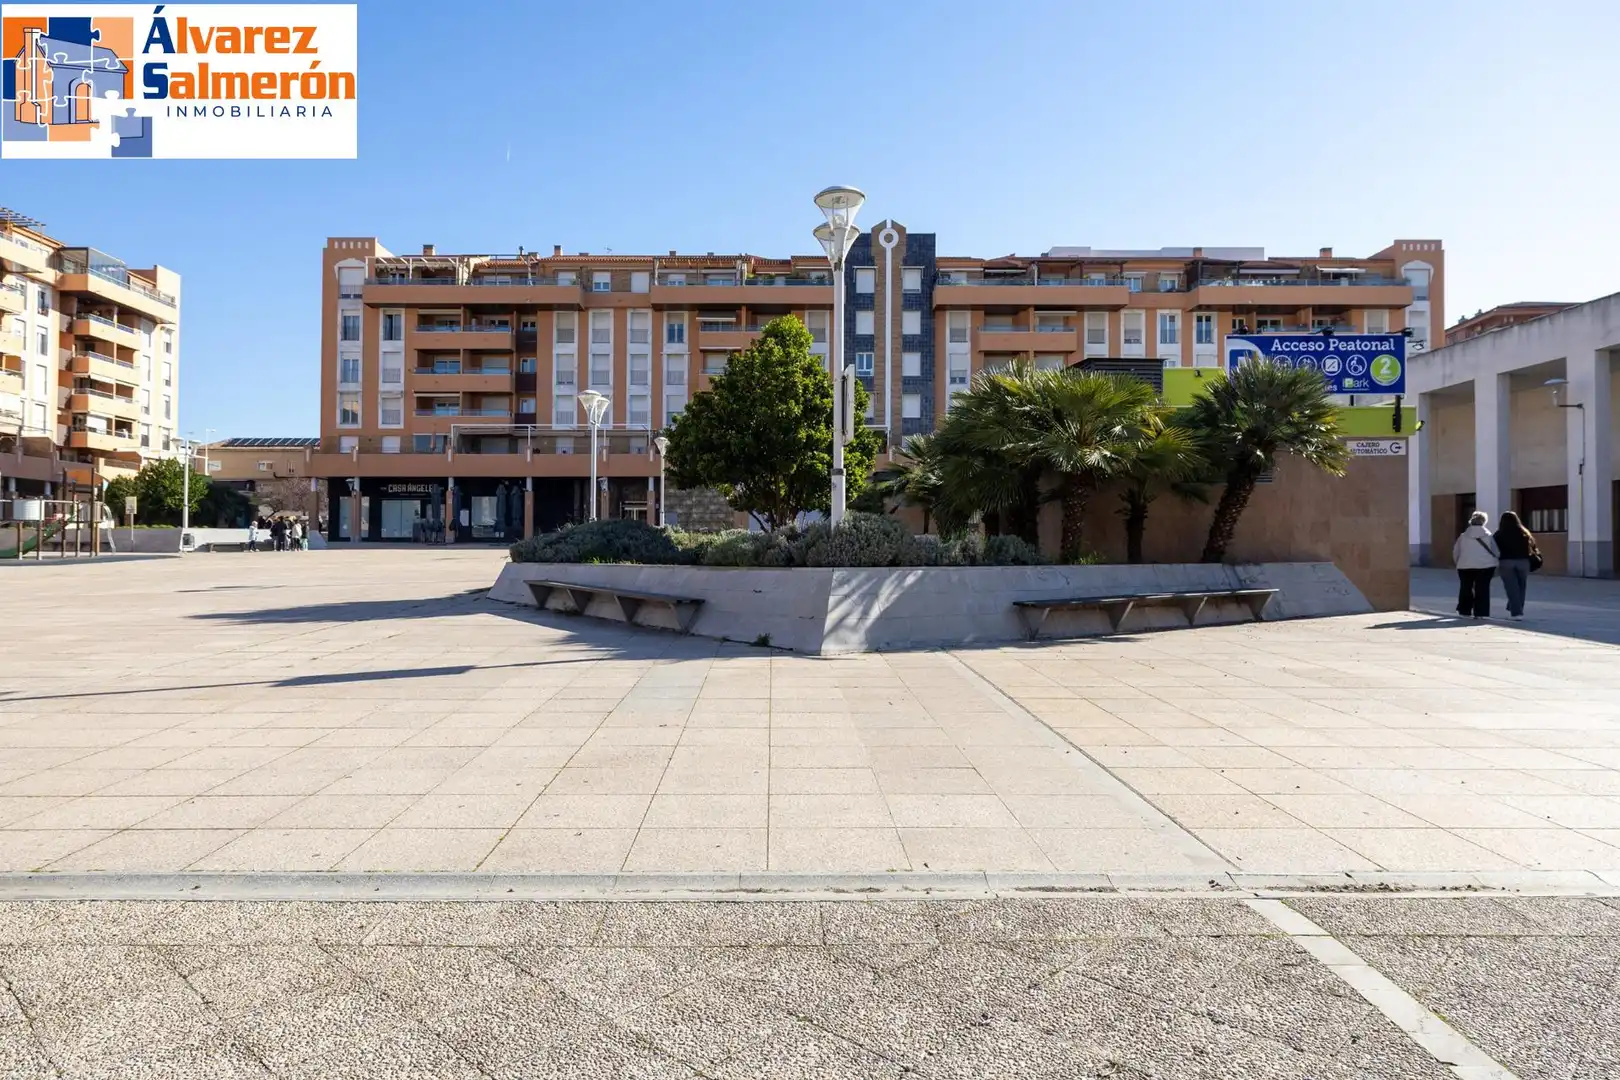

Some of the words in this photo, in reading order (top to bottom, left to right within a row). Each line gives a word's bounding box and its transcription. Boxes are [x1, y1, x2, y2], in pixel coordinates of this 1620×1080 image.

[1271, 339, 1325, 351] Acceso
[1328, 338, 1395, 351] Peatonal
[1380, 357, 1392, 374] 2
[388, 484, 406, 493] CASA
[407, 482, 435, 493] ÁNGELE
